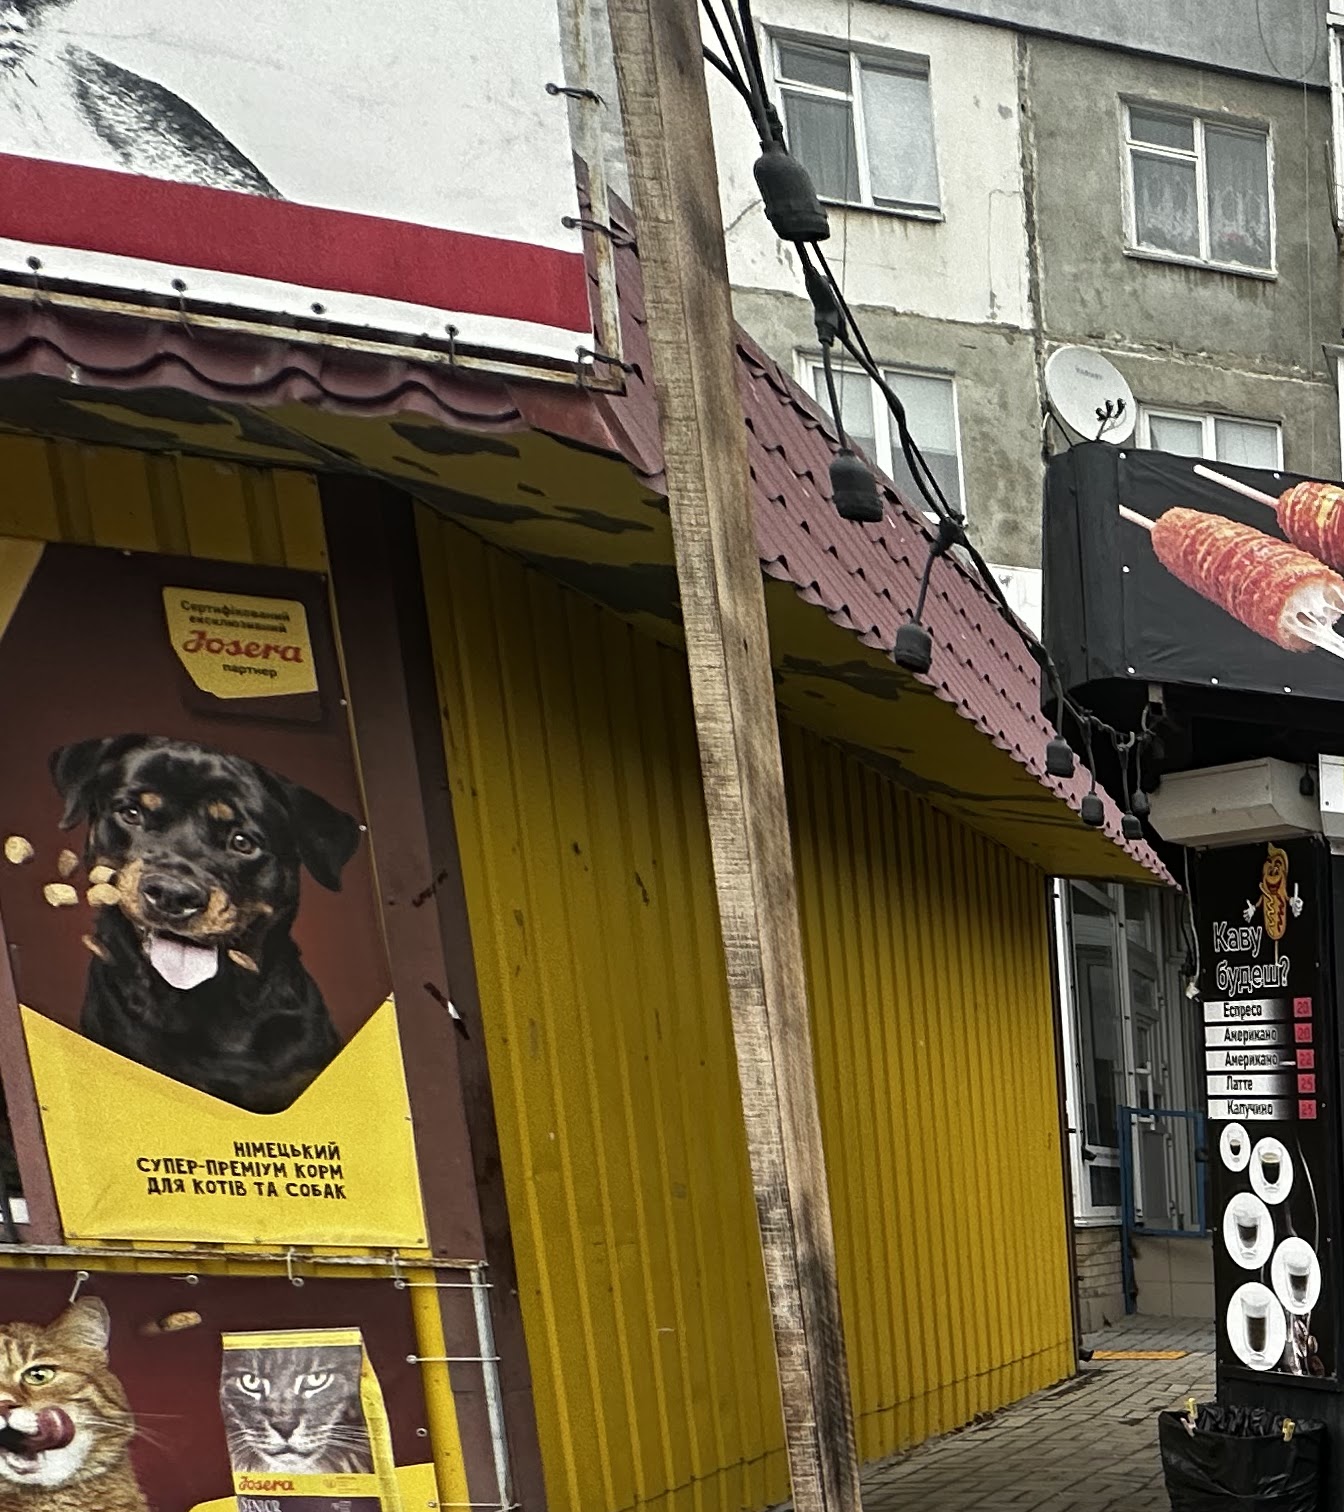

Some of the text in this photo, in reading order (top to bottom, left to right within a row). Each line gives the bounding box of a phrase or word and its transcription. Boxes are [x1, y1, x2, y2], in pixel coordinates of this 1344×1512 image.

[183, 629, 304, 663] Josera
[222, 663, 278, 678] партнер
[1213, 921, 1262, 958] Каву
[1216, 956, 1290, 997] будеш?
[1224, 1003, 1262, 1020] Еспресо
[1224, 1028, 1276, 1045] Американо
[1227, 1076, 1252, 1090] Латте
[1228, 1100, 1272, 1118] Капучино
[233, 1141, 341, 1161] НІМЕЦЬКИЙ
[136, 1157, 343, 1180] СУПЕР-ПРЕМІУМ КОРМ
[147, 1177, 347, 1199] ДЛЯ КОТІВ ТА СОБАК
[239, 1476, 294, 1492] Josera
